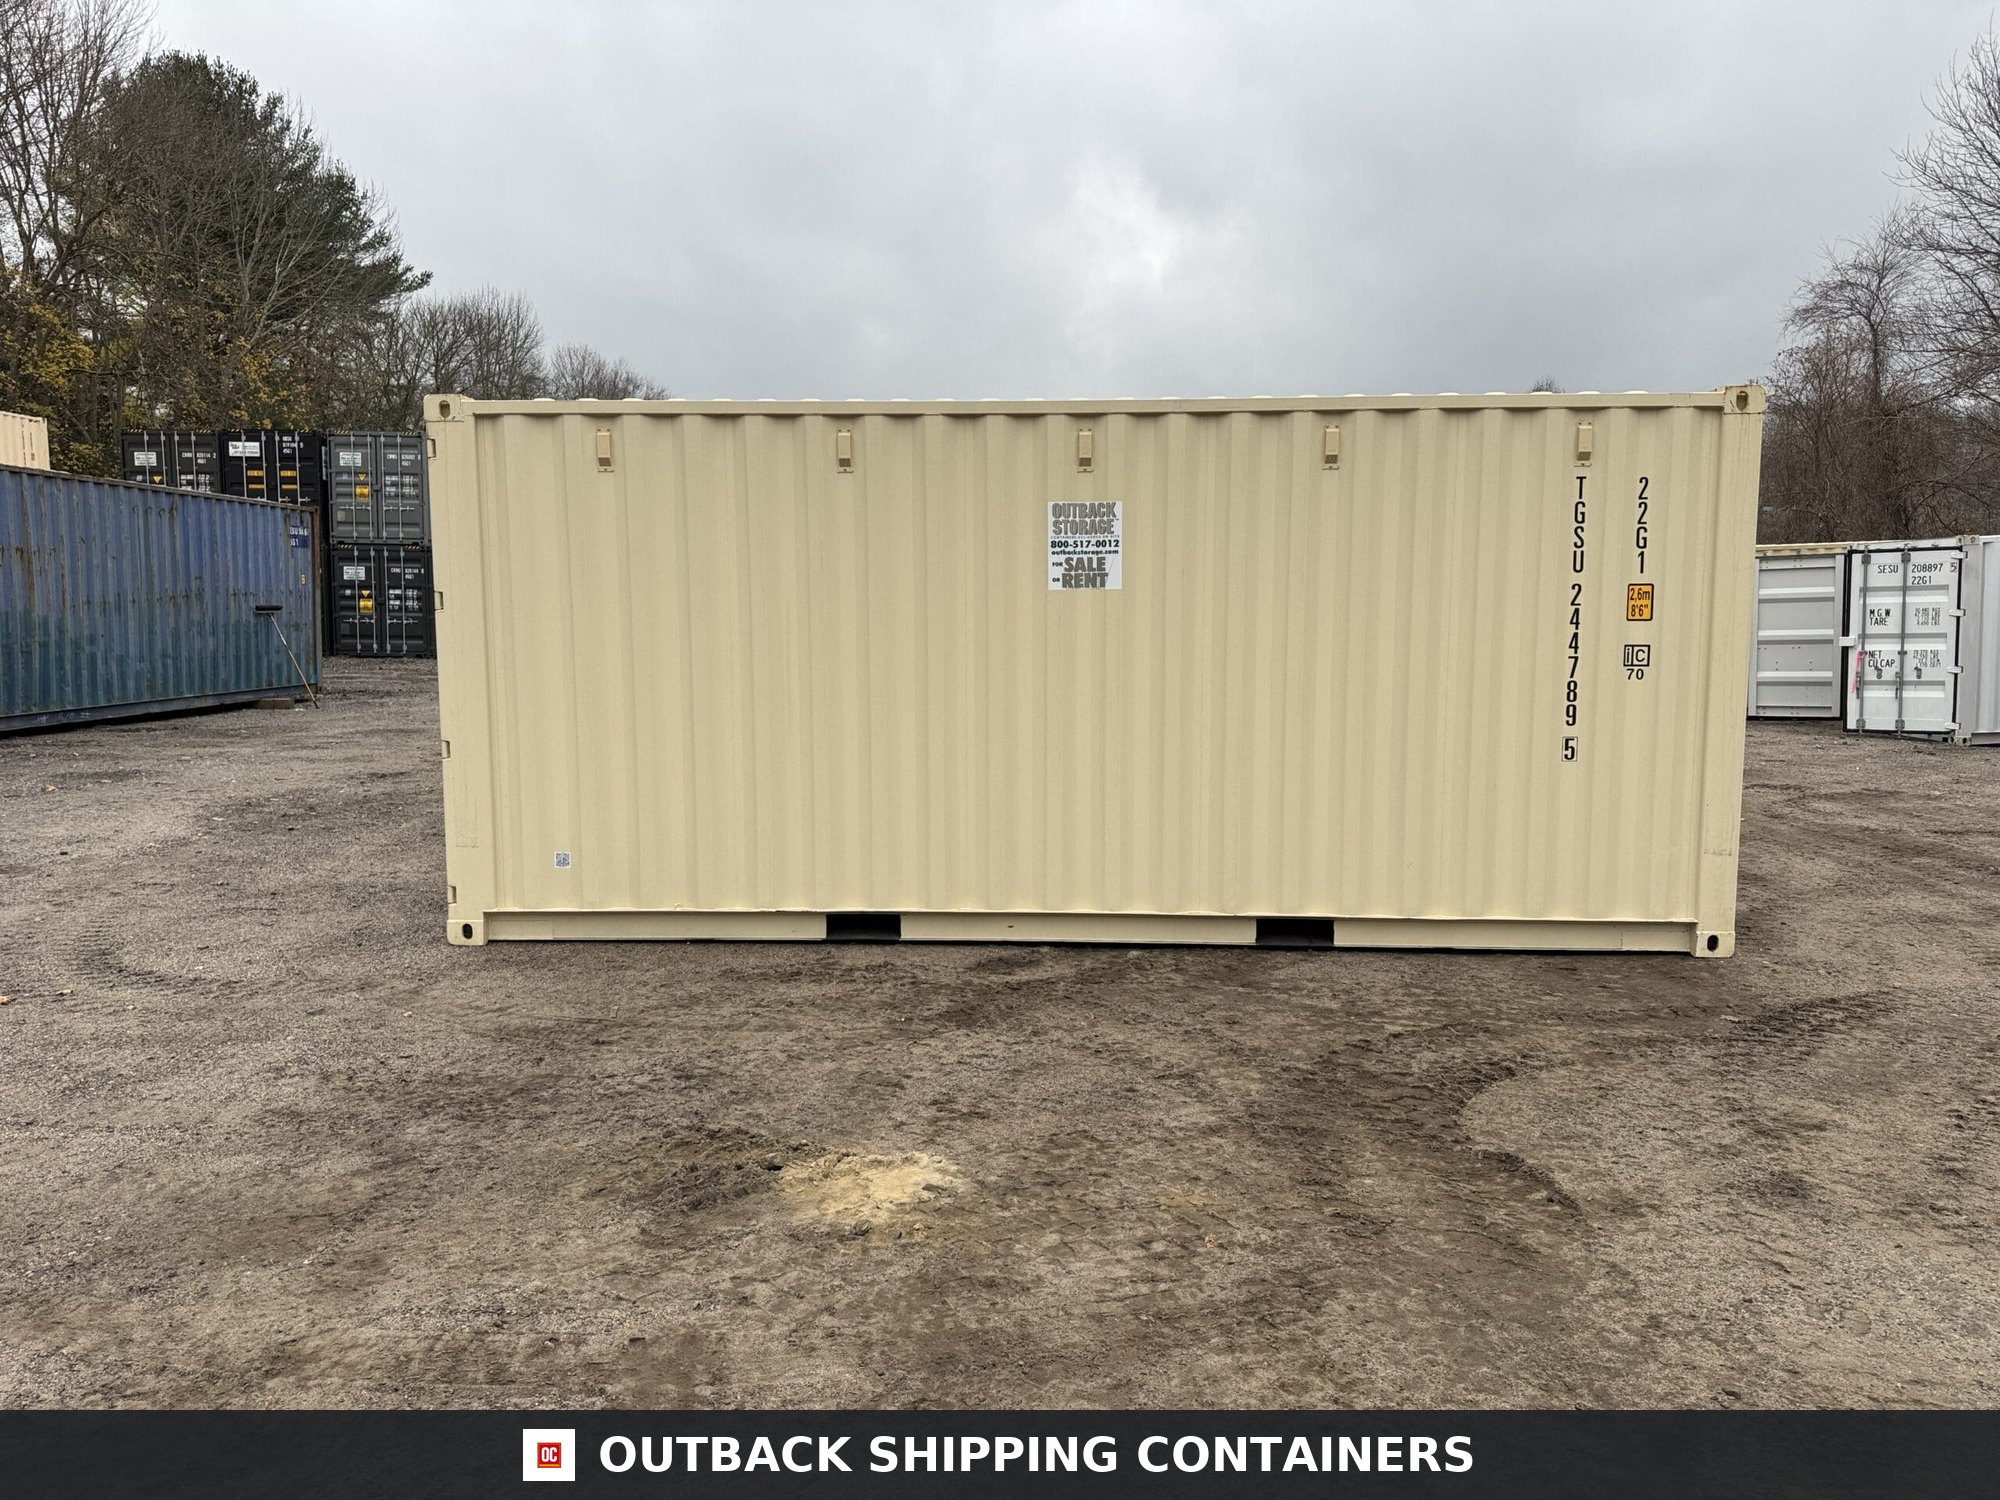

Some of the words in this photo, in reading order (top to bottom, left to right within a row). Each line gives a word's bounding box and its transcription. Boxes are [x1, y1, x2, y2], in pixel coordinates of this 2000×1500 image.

[1052, 502, 1117, 519] OUTBACK
[1052, 518, 1115, 535] STORAGE
[1572, 476, 1587, 573] TGSU
[1636, 477, 1649, 574] 22G1
[1050, 539, 1120, 548] 800-517-0012
[1051, 548, 1119, 556] outbackstorage.com
[1064, 556, 1106, 572] SALE
[1878, 564, 1899, 574] SESU
[1911, 563, 1943, 573] 208897
[1950, 563, 1957, 573] 5
[1062, 572, 1109, 588] RENT
[1911, 576, 1932, 585] 22G1
[1630, 588, 1650, 602] 2,6m
[1631, 604, 1649, 617] 8'6"
[1869, 617, 1888, 626] TARE
[1565, 583, 1582, 726] 244789
[1868, 650, 1882, 658] NET
[1626, 669, 1644, 680] 70
[1564, 738, 1575, 760] 5
